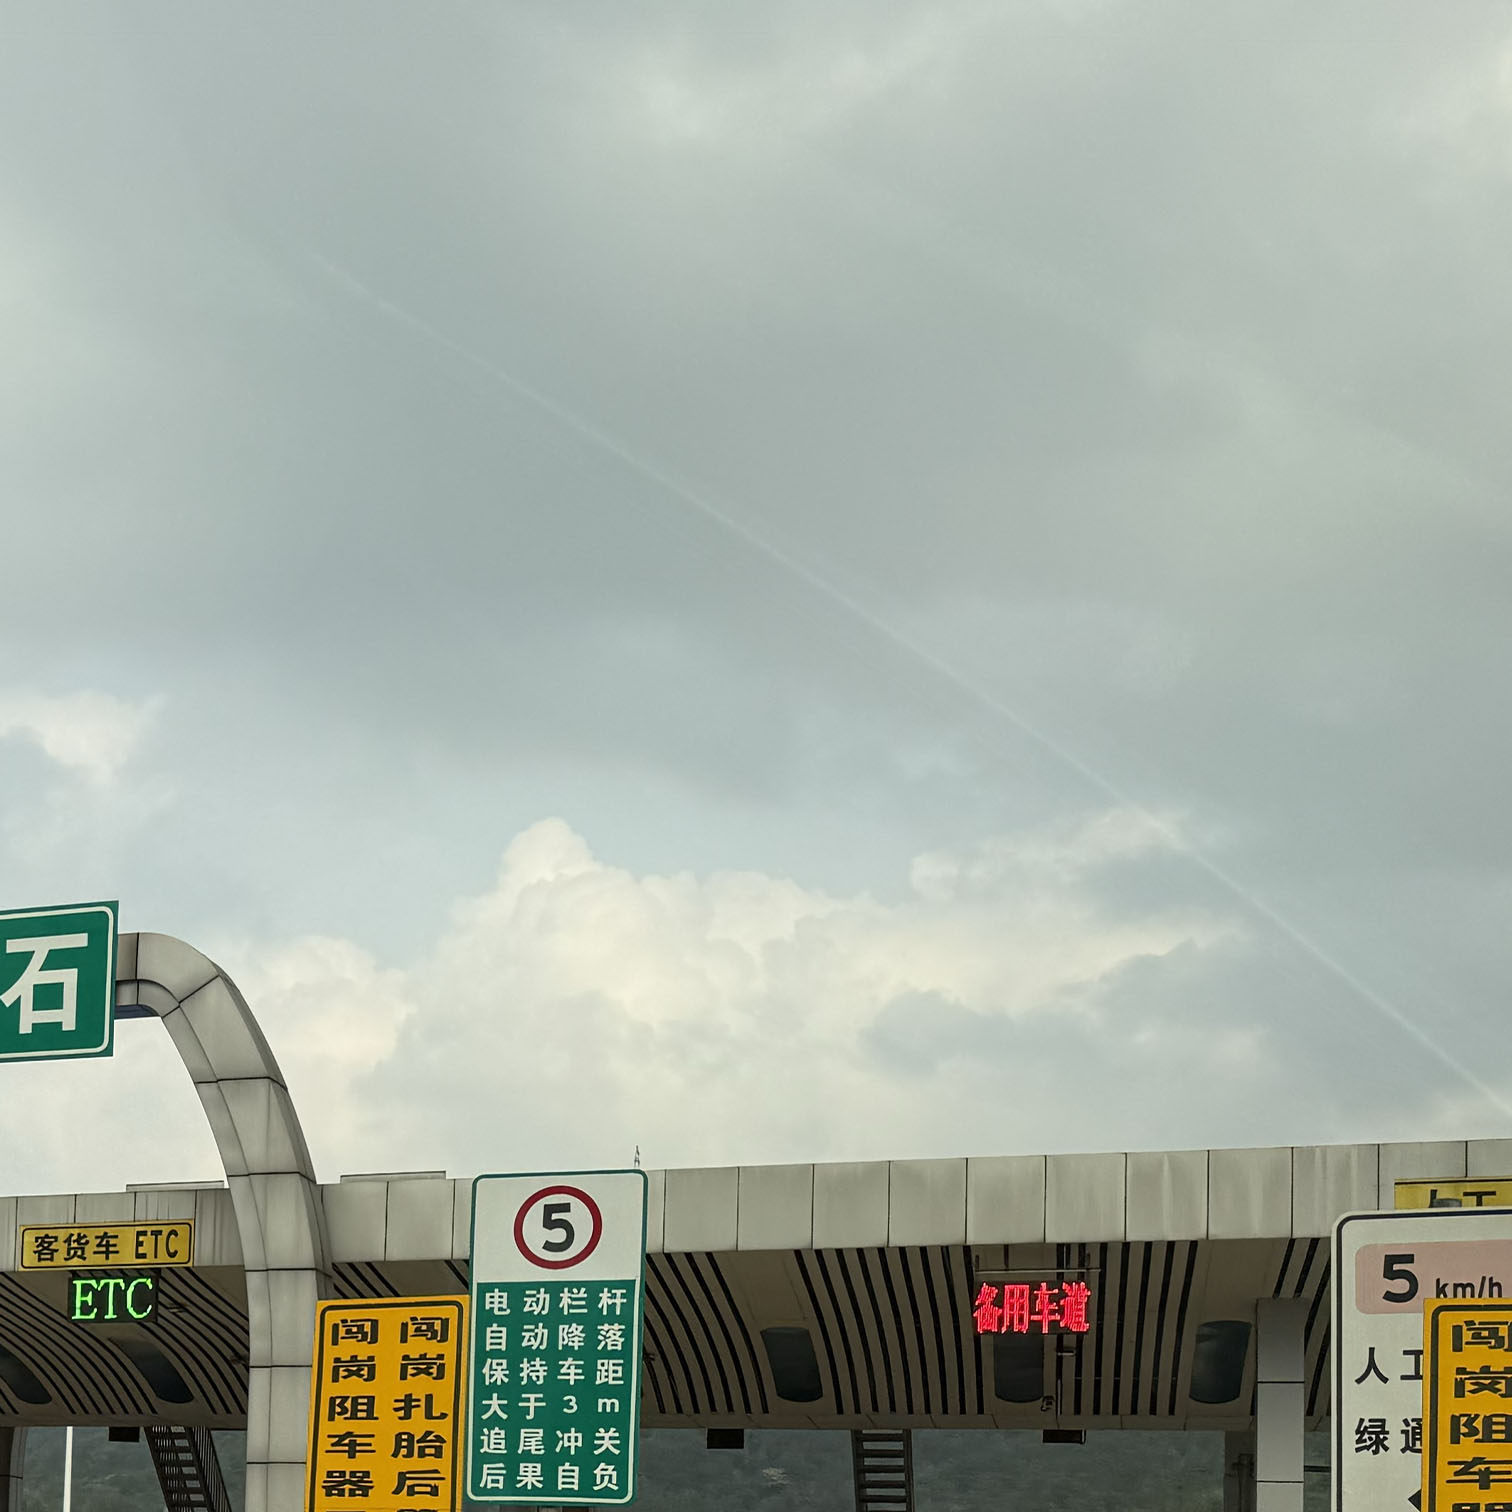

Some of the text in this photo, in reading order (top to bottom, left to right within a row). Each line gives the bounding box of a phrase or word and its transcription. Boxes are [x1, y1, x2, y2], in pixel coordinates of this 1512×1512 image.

[0, 933, 88, 1035] 石
[542, 1202, 575, 1253] 5
[33, 1229, 179, 1263] 客货车 ETC
[1382, 1254, 1503, 1304] 5 km/h
[72, 1277, 153, 1320] ETC
[484, 1287, 627, 1316] 电动栏杆
[973, 1282, 1091, 1334] 备用车道
[484, 1323, 625, 1352] 自动降落
[482, 1358, 625, 1386] 保持车距
[479, 1427, 621, 1456] 追尾冲关
[478, 1462, 620, 1492] 后果自负
